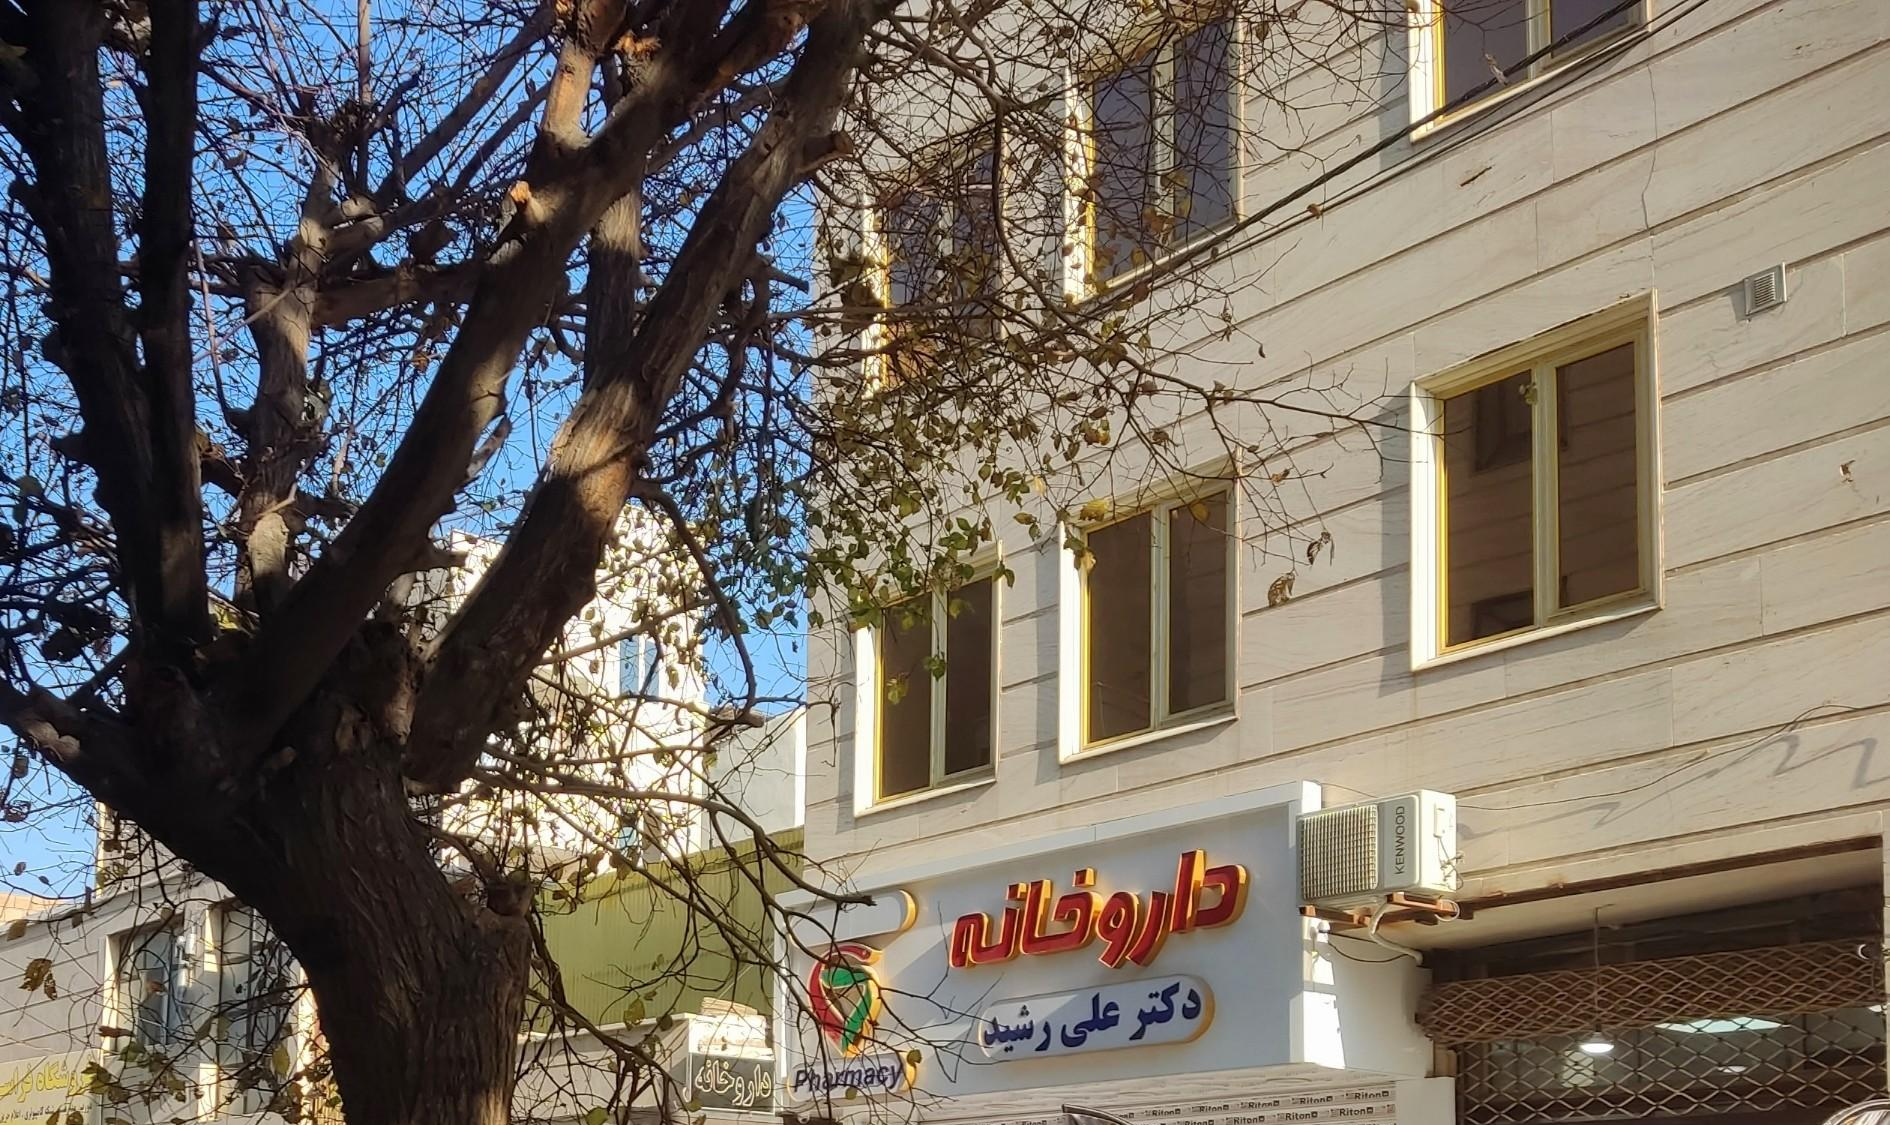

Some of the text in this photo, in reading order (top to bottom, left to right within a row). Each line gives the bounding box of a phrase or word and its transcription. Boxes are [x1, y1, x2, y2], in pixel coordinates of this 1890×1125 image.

[1394, 806, 1406, 875] KENWOOD
[950, 848, 1251, 969] داروخانه
[983, 982, 1202, 1052] دکتر علی رشید
[695, 1059, 772, 1108] داروخانه
[794, 1058, 903, 1093] Pharmacy
